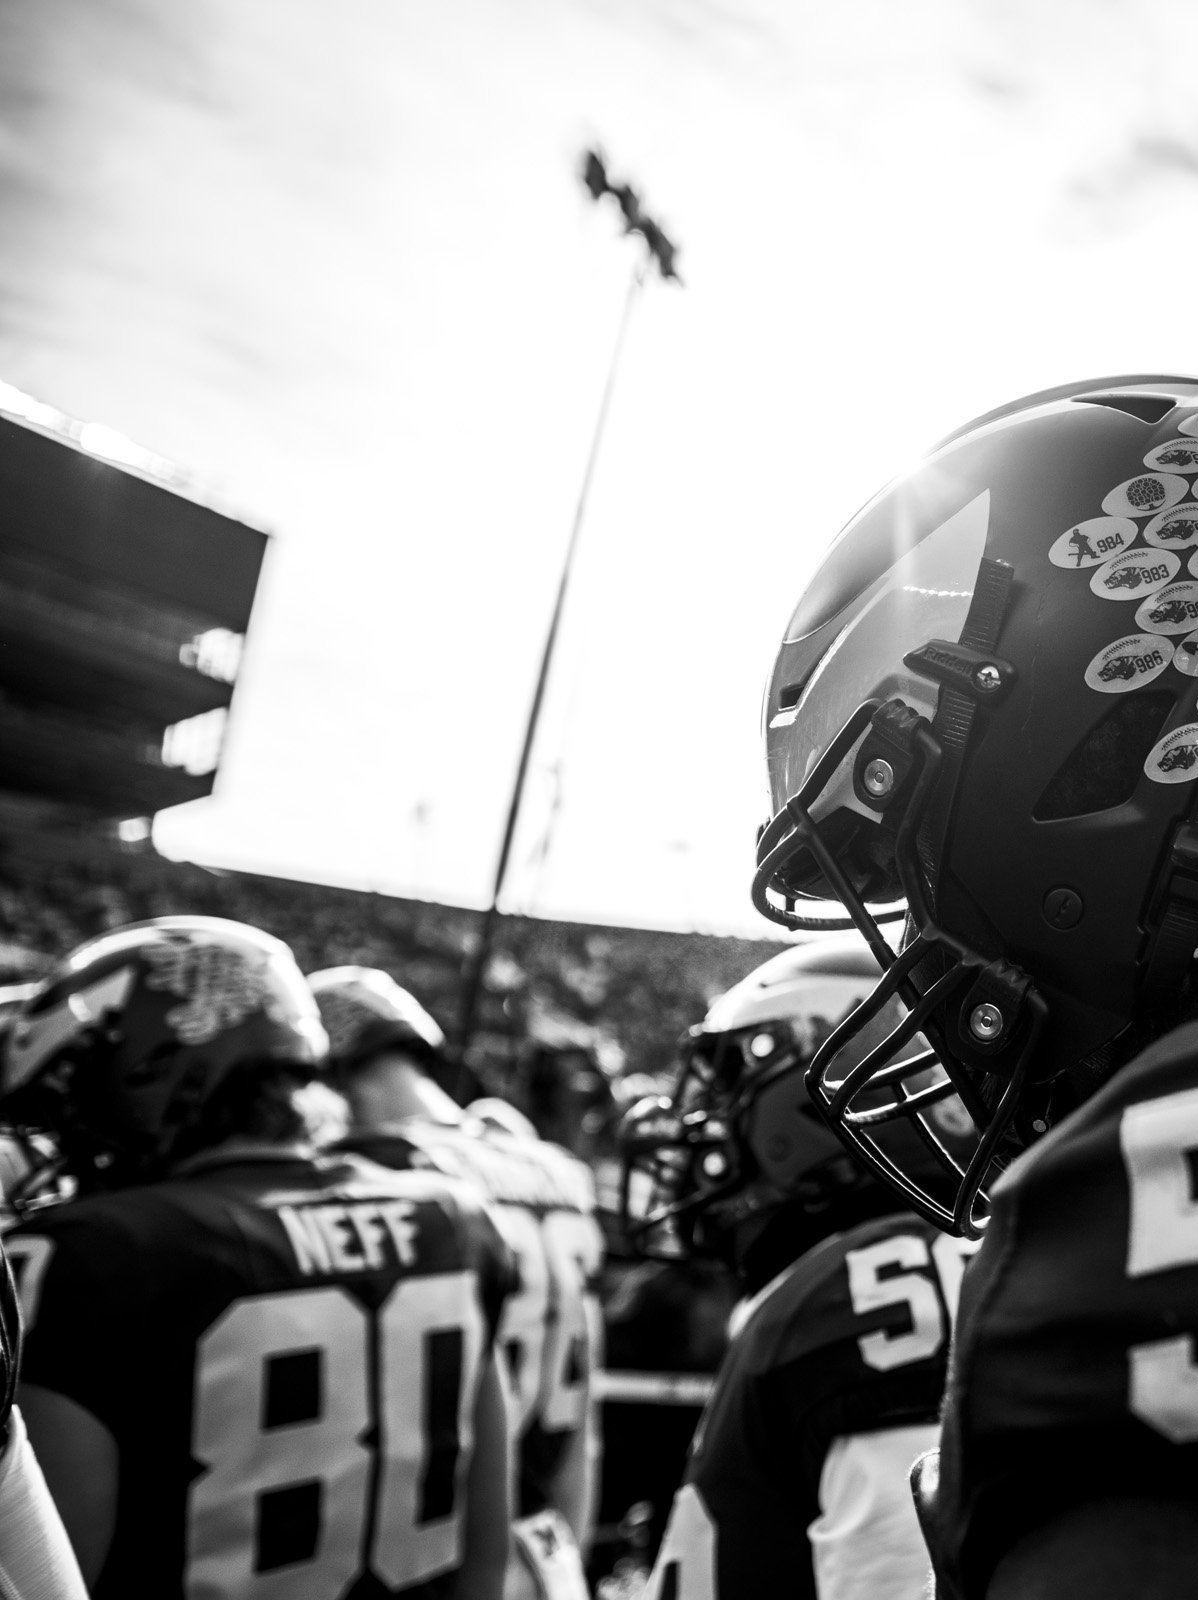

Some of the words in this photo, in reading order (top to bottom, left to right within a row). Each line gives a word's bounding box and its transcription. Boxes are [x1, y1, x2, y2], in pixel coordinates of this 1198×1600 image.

[1096, 532, 1125, 553] 984
[1142, 563, 1170, 584] 983
[1135, 650, 1164, 674] 986
[278, 1202, 418, 1275] NEFF
[183, 1270, 484, 1600] 80
